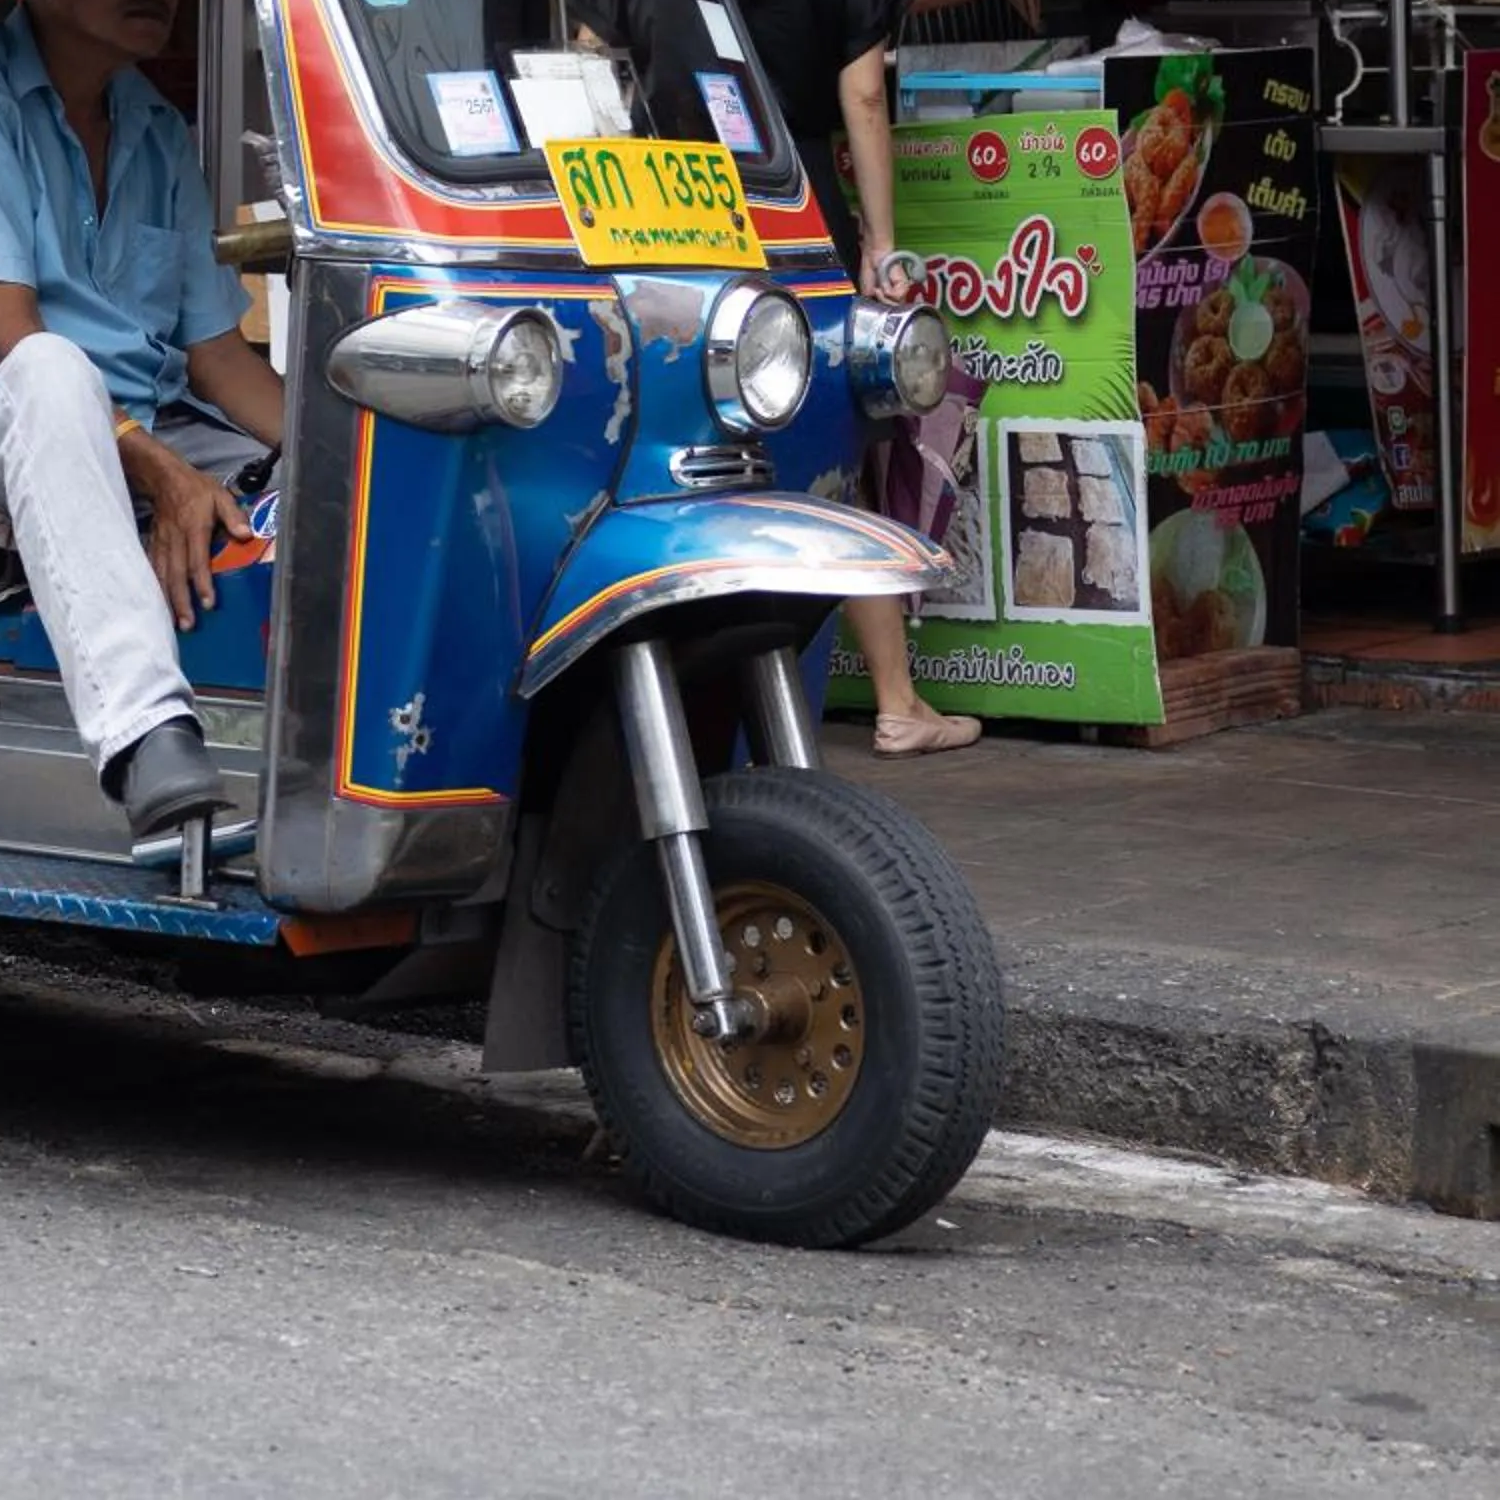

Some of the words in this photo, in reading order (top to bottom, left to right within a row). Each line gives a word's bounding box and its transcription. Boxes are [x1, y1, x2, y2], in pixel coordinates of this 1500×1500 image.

[1263, 79, 1311, 113] กรอบ
[561, 146, 635, 215] สก
[643, 150, 740, 213] 1355
[1028, 163, 1038, 178] 2
